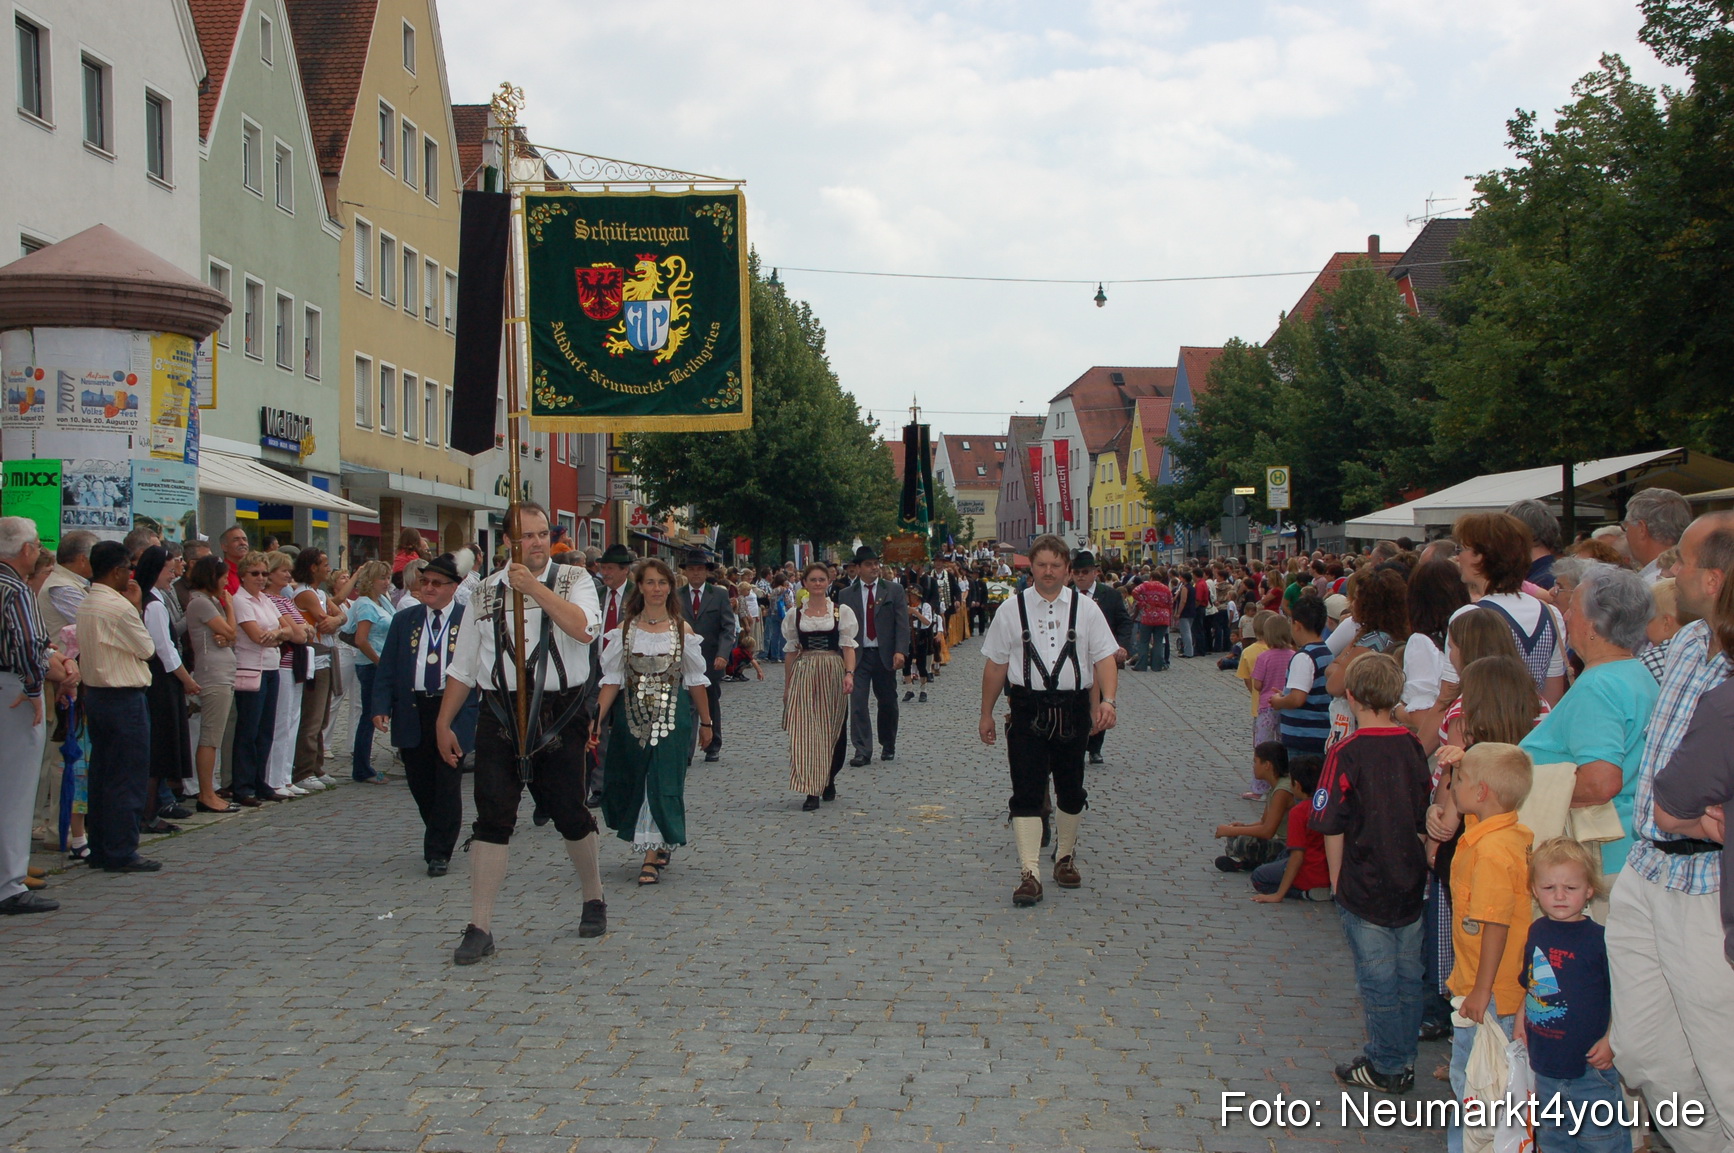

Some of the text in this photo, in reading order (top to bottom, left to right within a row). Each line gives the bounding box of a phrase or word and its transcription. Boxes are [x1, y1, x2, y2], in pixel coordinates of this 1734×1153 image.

[575, 219, 690, 246] Schützengau
[60, 371, 76, 413] 2007
[263, 406, 313, 441] Weltbild
